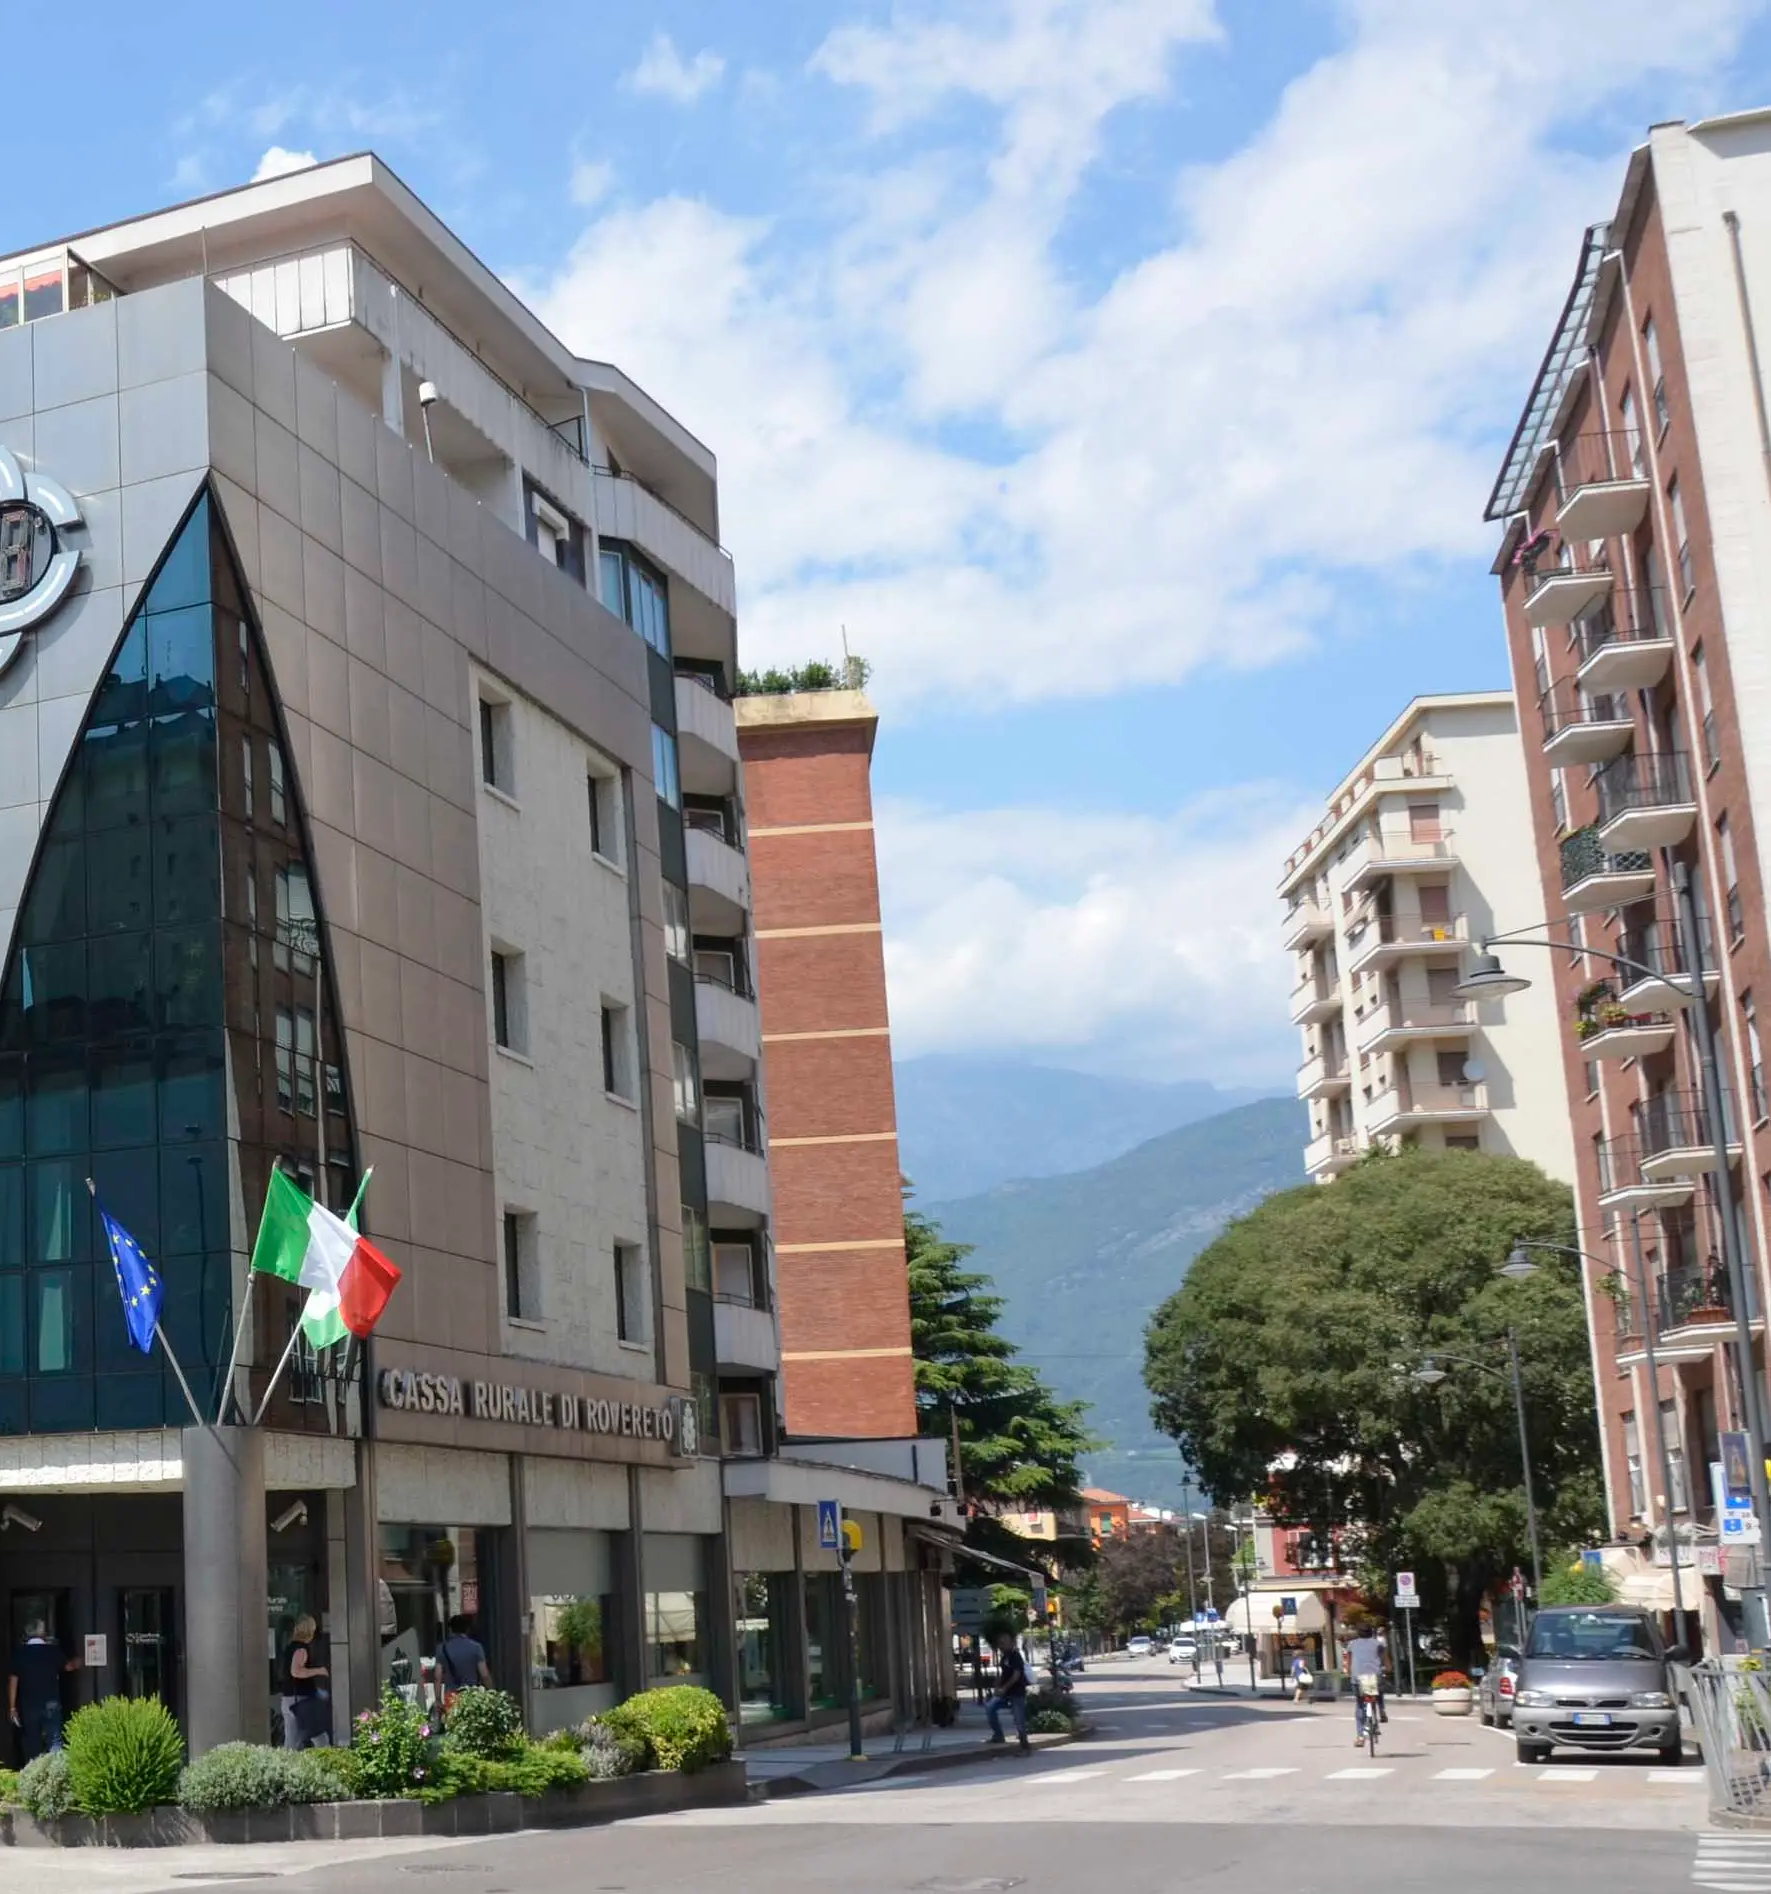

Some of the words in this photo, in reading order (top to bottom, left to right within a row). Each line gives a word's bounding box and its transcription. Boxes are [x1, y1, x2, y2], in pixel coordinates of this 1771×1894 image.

[384, 1368, 464, 1416] CASSA
[475, 1381, 554, 1427] RURALE
[561, 1394, 579, 1429] DI
[587, 1398, 673, 1441] ROVERETO
